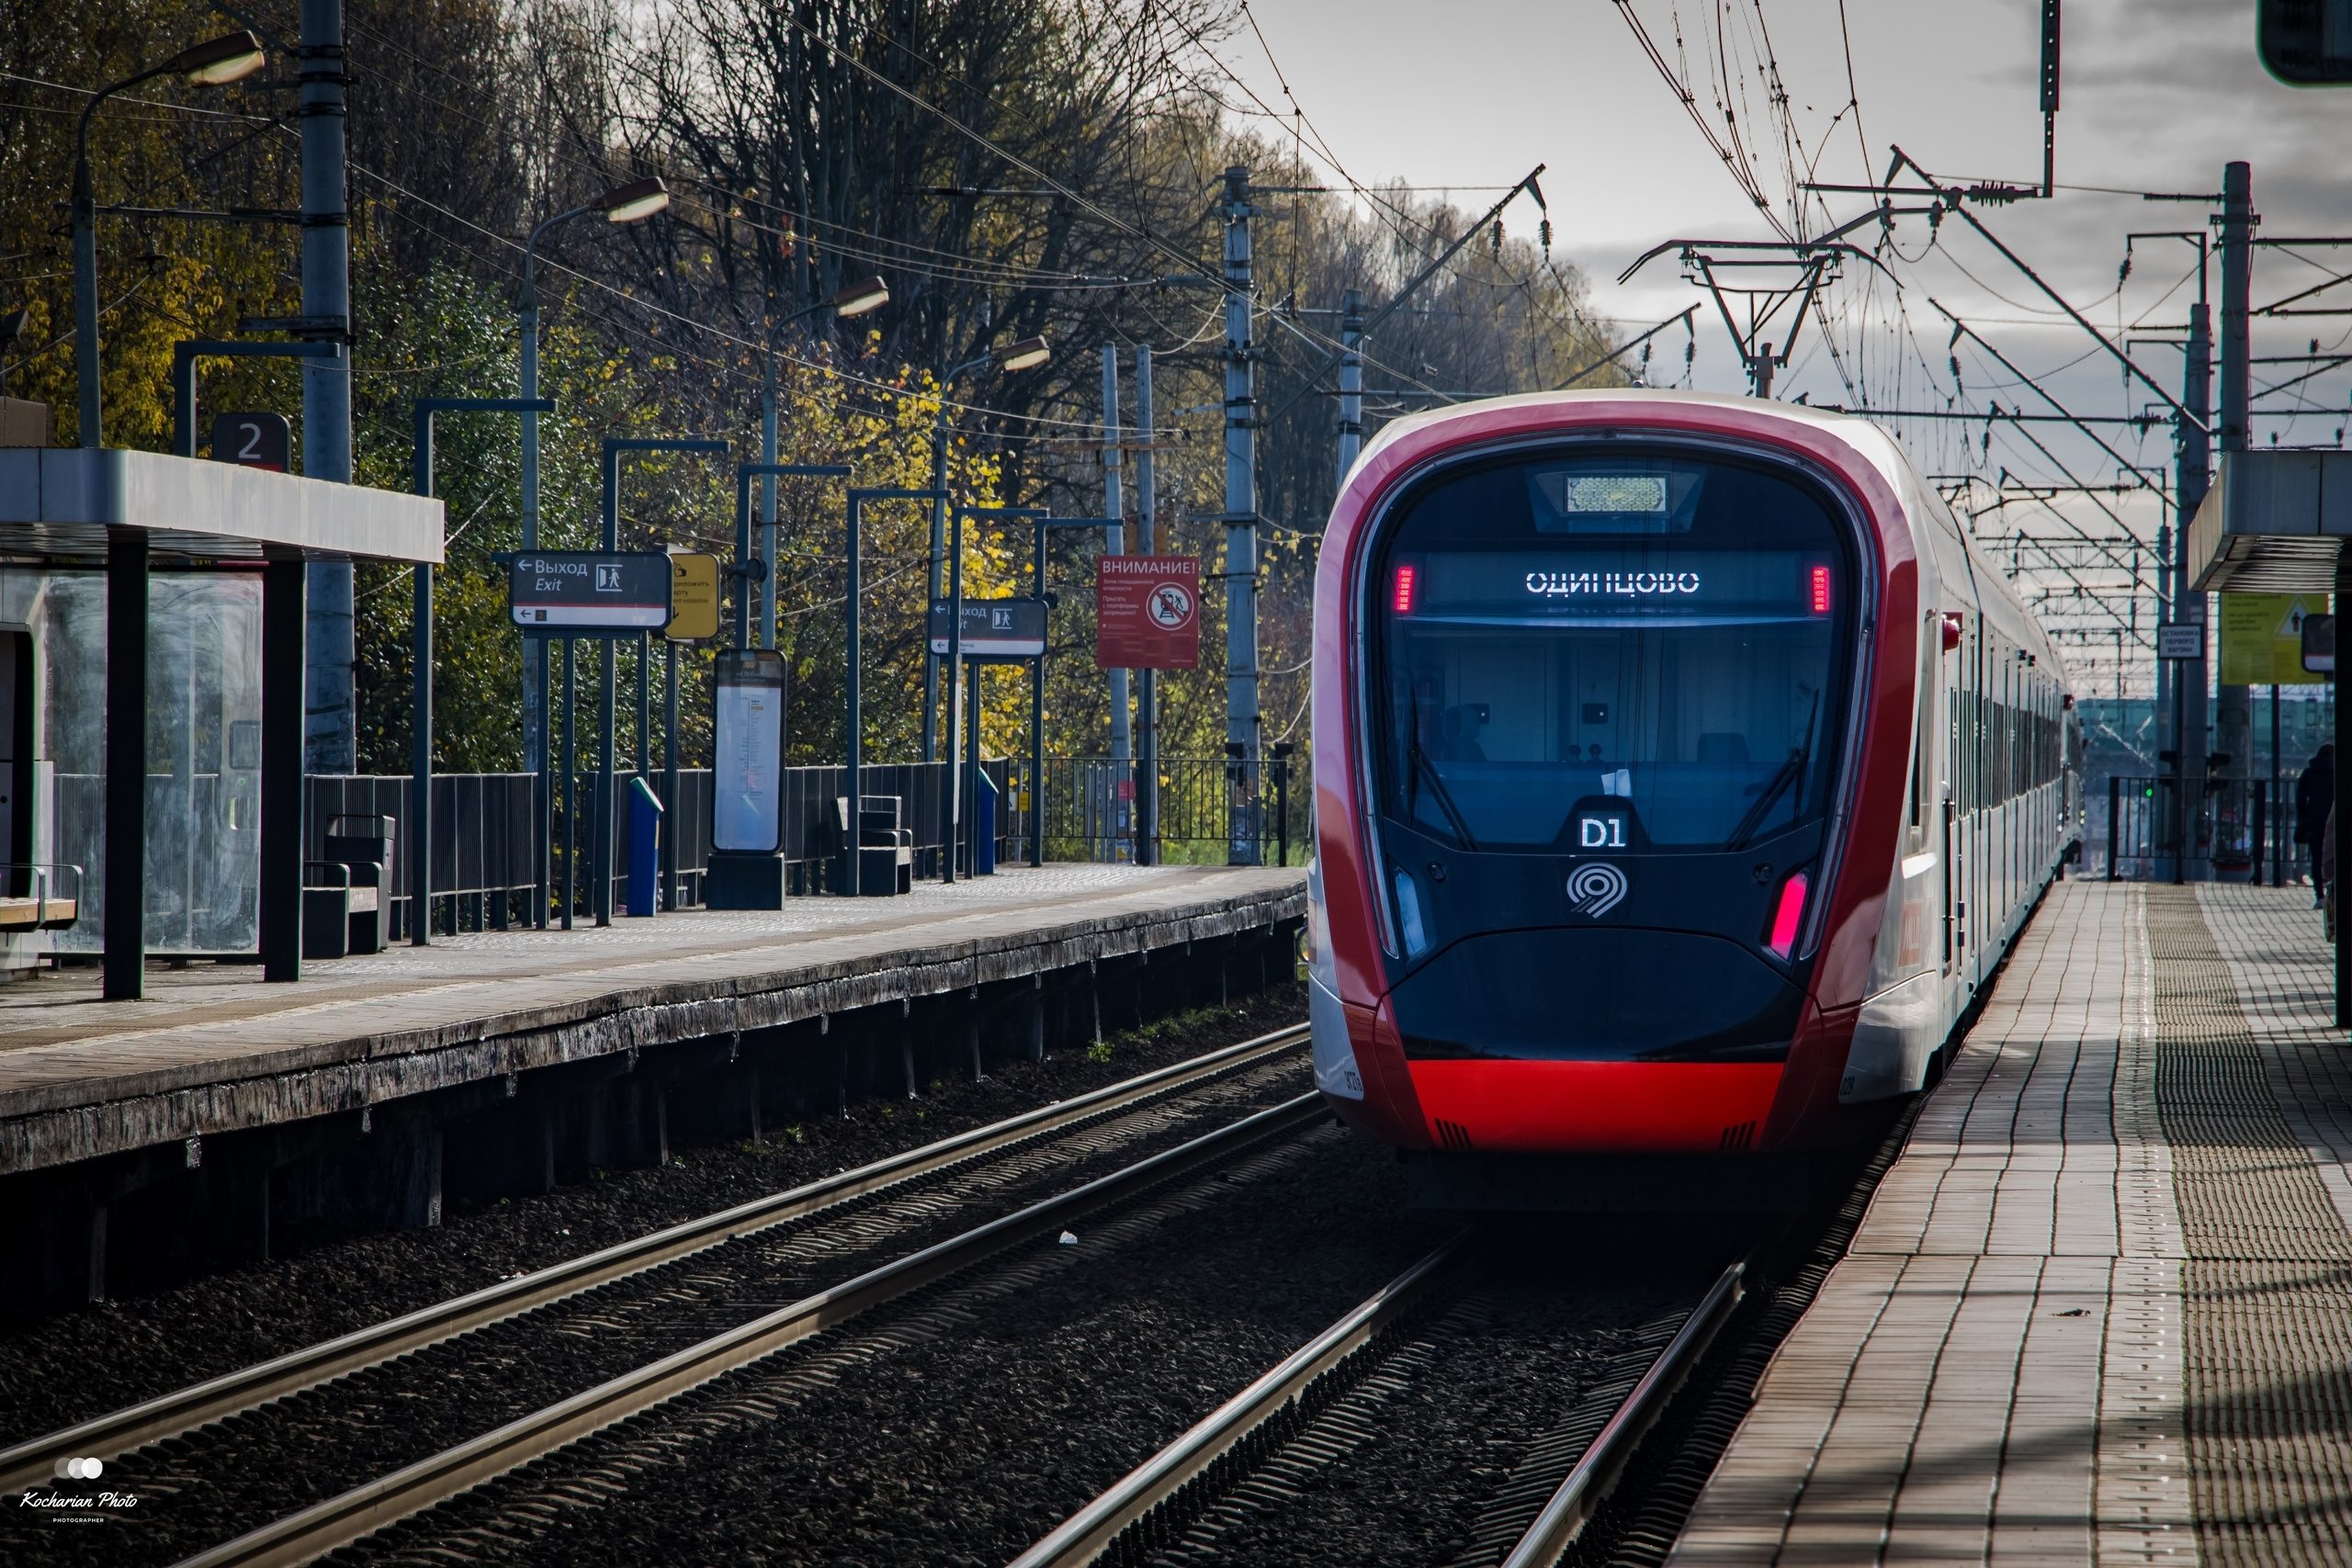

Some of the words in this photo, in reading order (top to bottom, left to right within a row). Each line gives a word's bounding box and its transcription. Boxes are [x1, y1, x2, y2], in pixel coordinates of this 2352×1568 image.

[238, 423, 262, 459] 2
[535, 558, 588, 578] Выход
[1102, 560, 1195, 574] ВНИМАНИЕ!
[535, 578, 562, 592] Exit
[1525, 571, 1701, 599] ОДИНЦОВО
[1581, 818, 1626, 847] D1
[1839, 1076, 1855, 1096] 029
